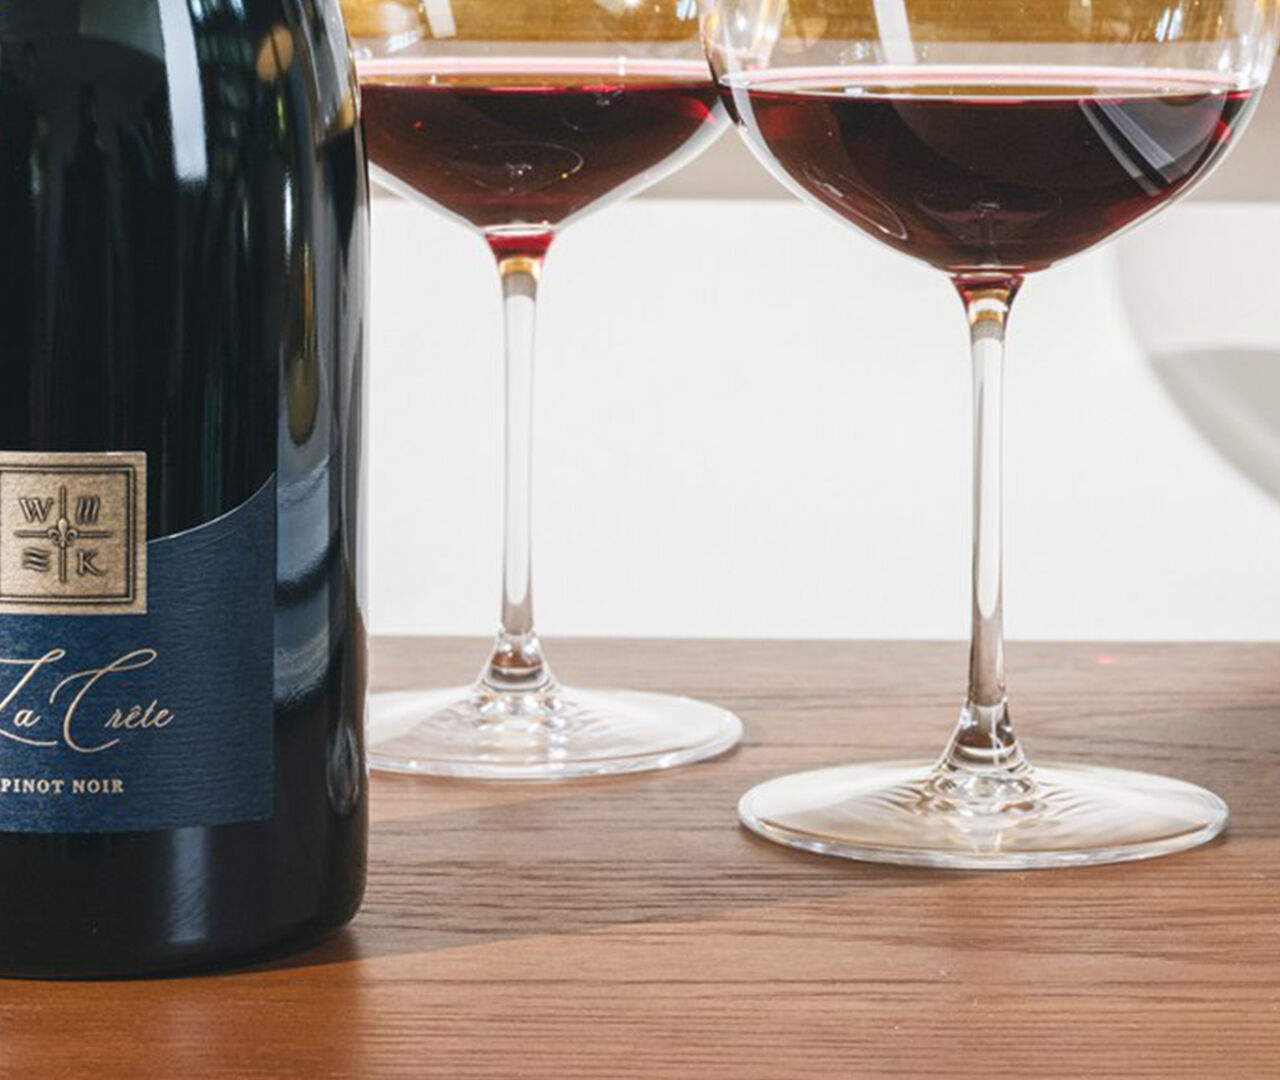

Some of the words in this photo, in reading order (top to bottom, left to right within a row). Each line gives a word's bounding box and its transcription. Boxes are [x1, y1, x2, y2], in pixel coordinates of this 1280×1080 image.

[49, 648, 174, 754] Crête
[0, 778, 65, 794] PINOT
[72, 778, 125, 794] NOIR
